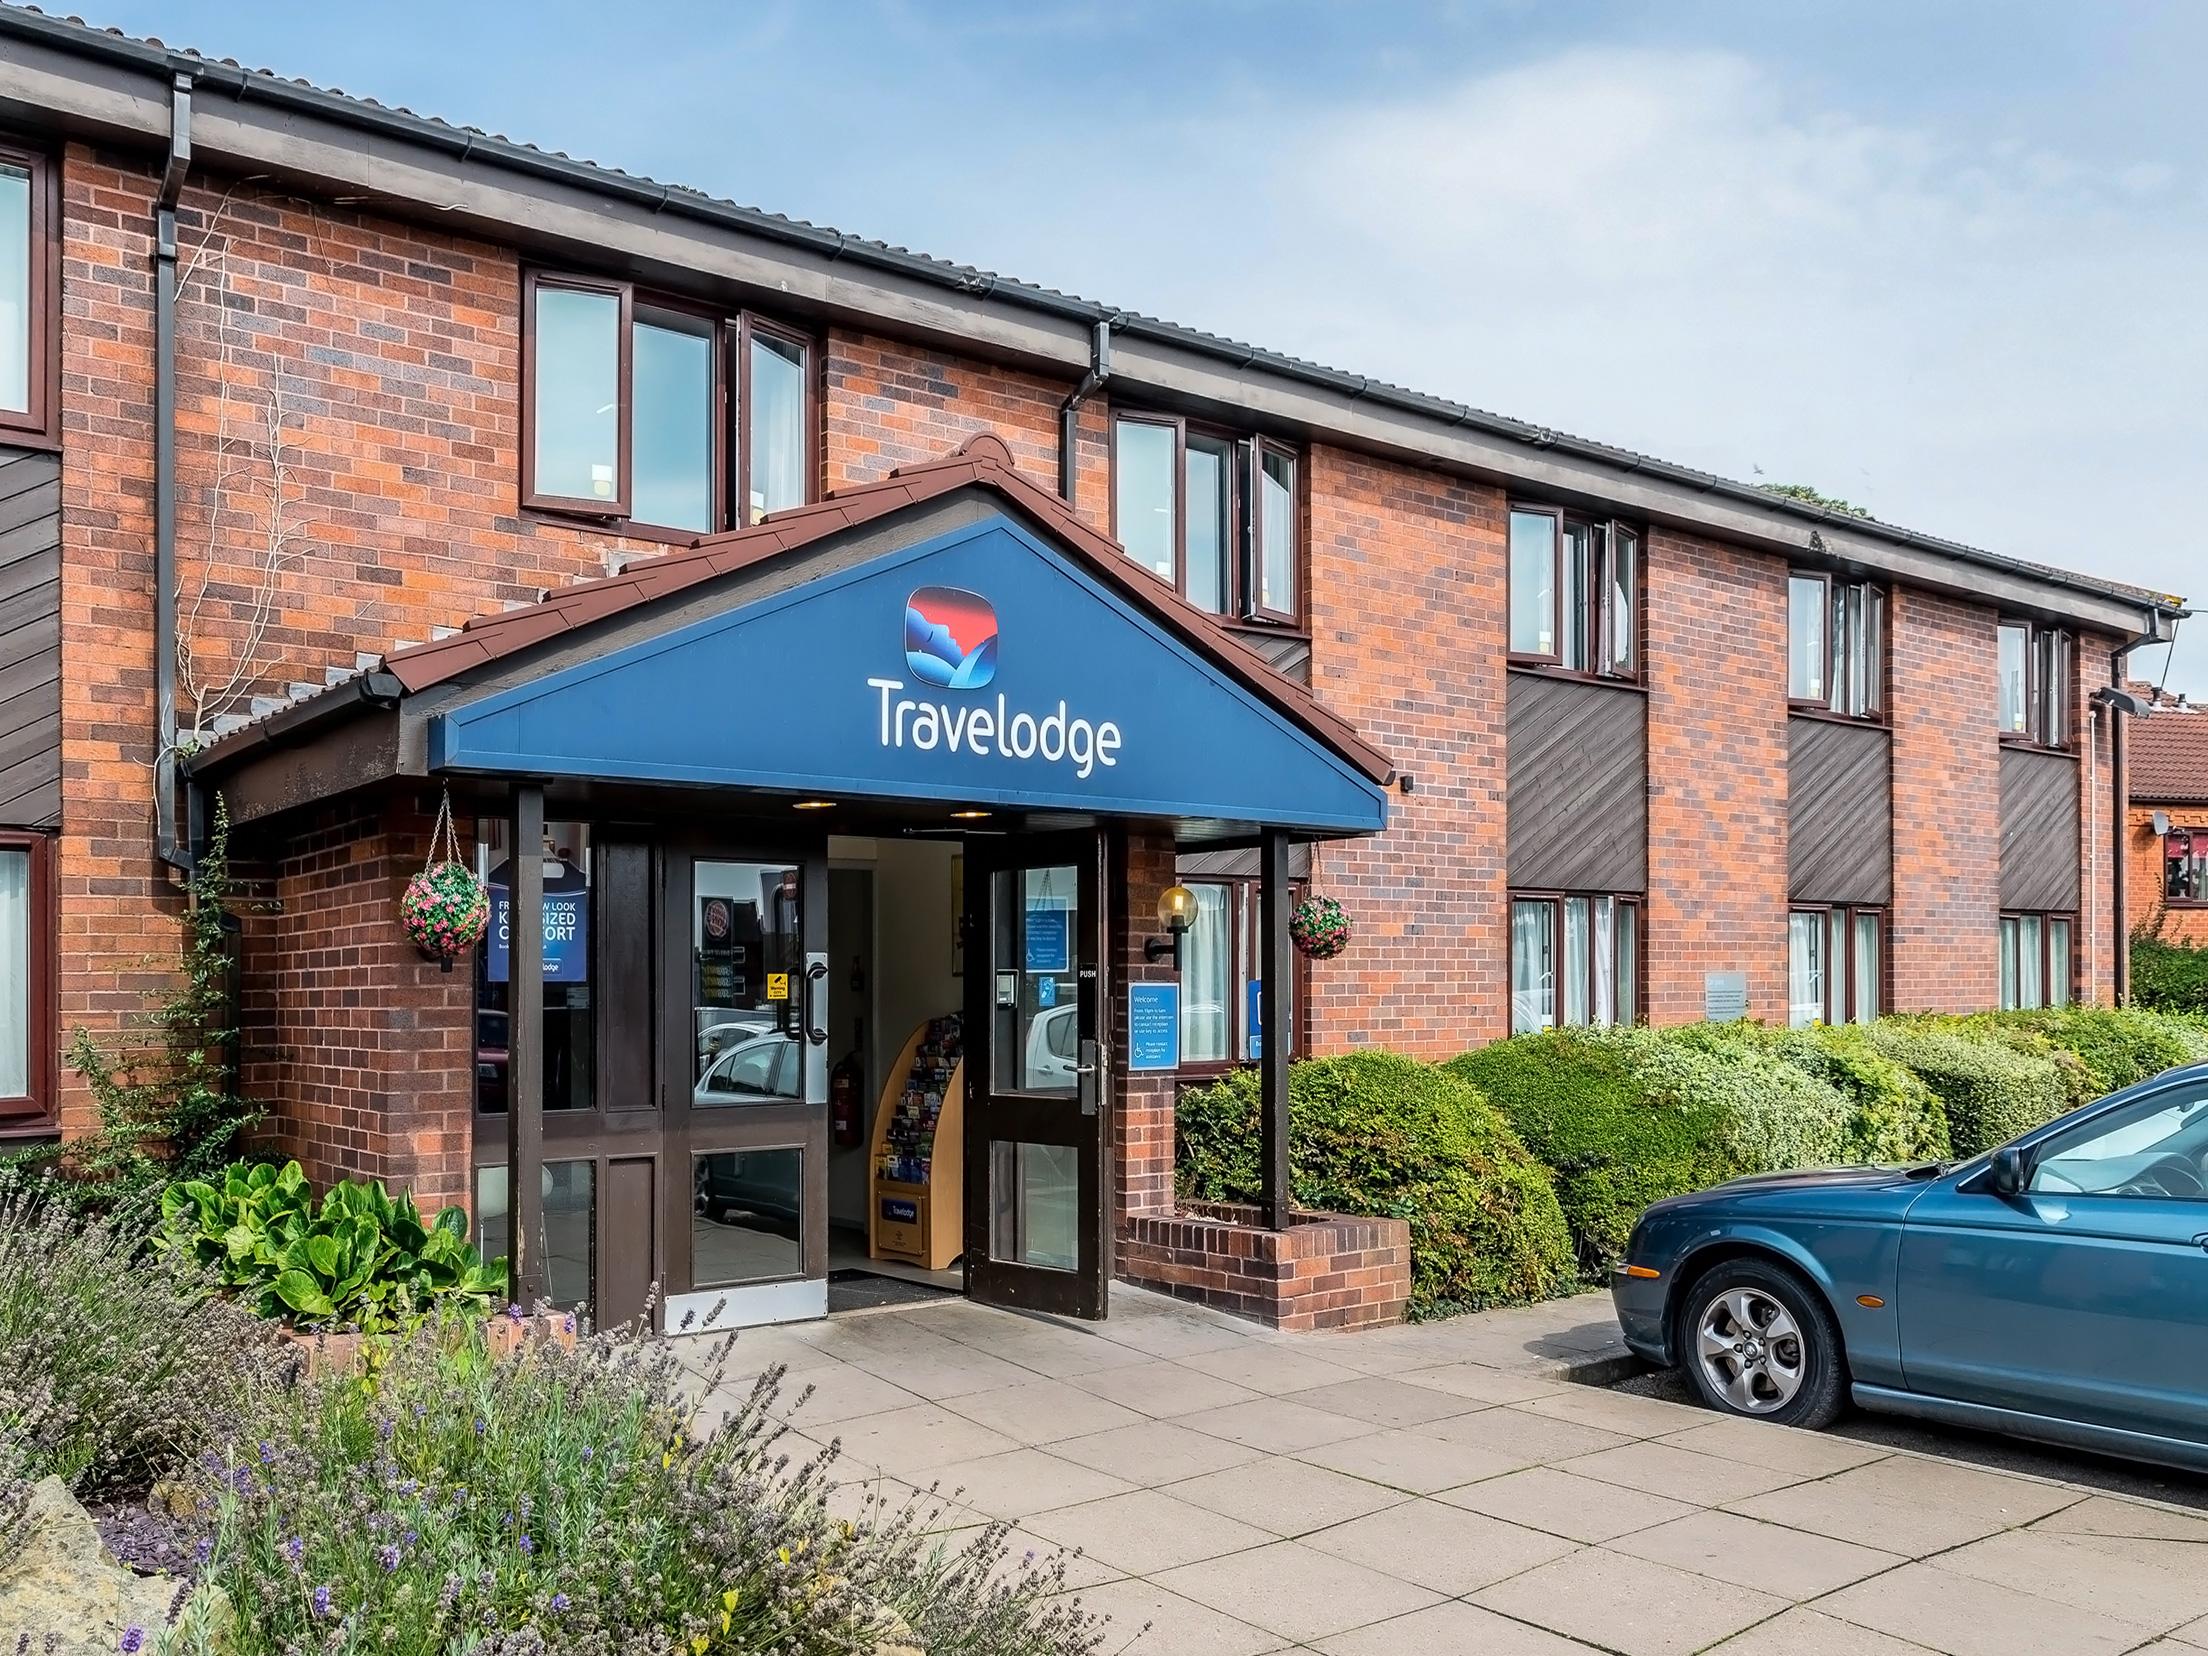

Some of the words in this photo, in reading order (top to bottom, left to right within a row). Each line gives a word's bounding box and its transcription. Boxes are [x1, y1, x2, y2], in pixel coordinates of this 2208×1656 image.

[867, 678, 1121, 779] Travelodge
[552, 902, 576, 911] LOOK
[1080, 970, 1097, 978] PUSH
